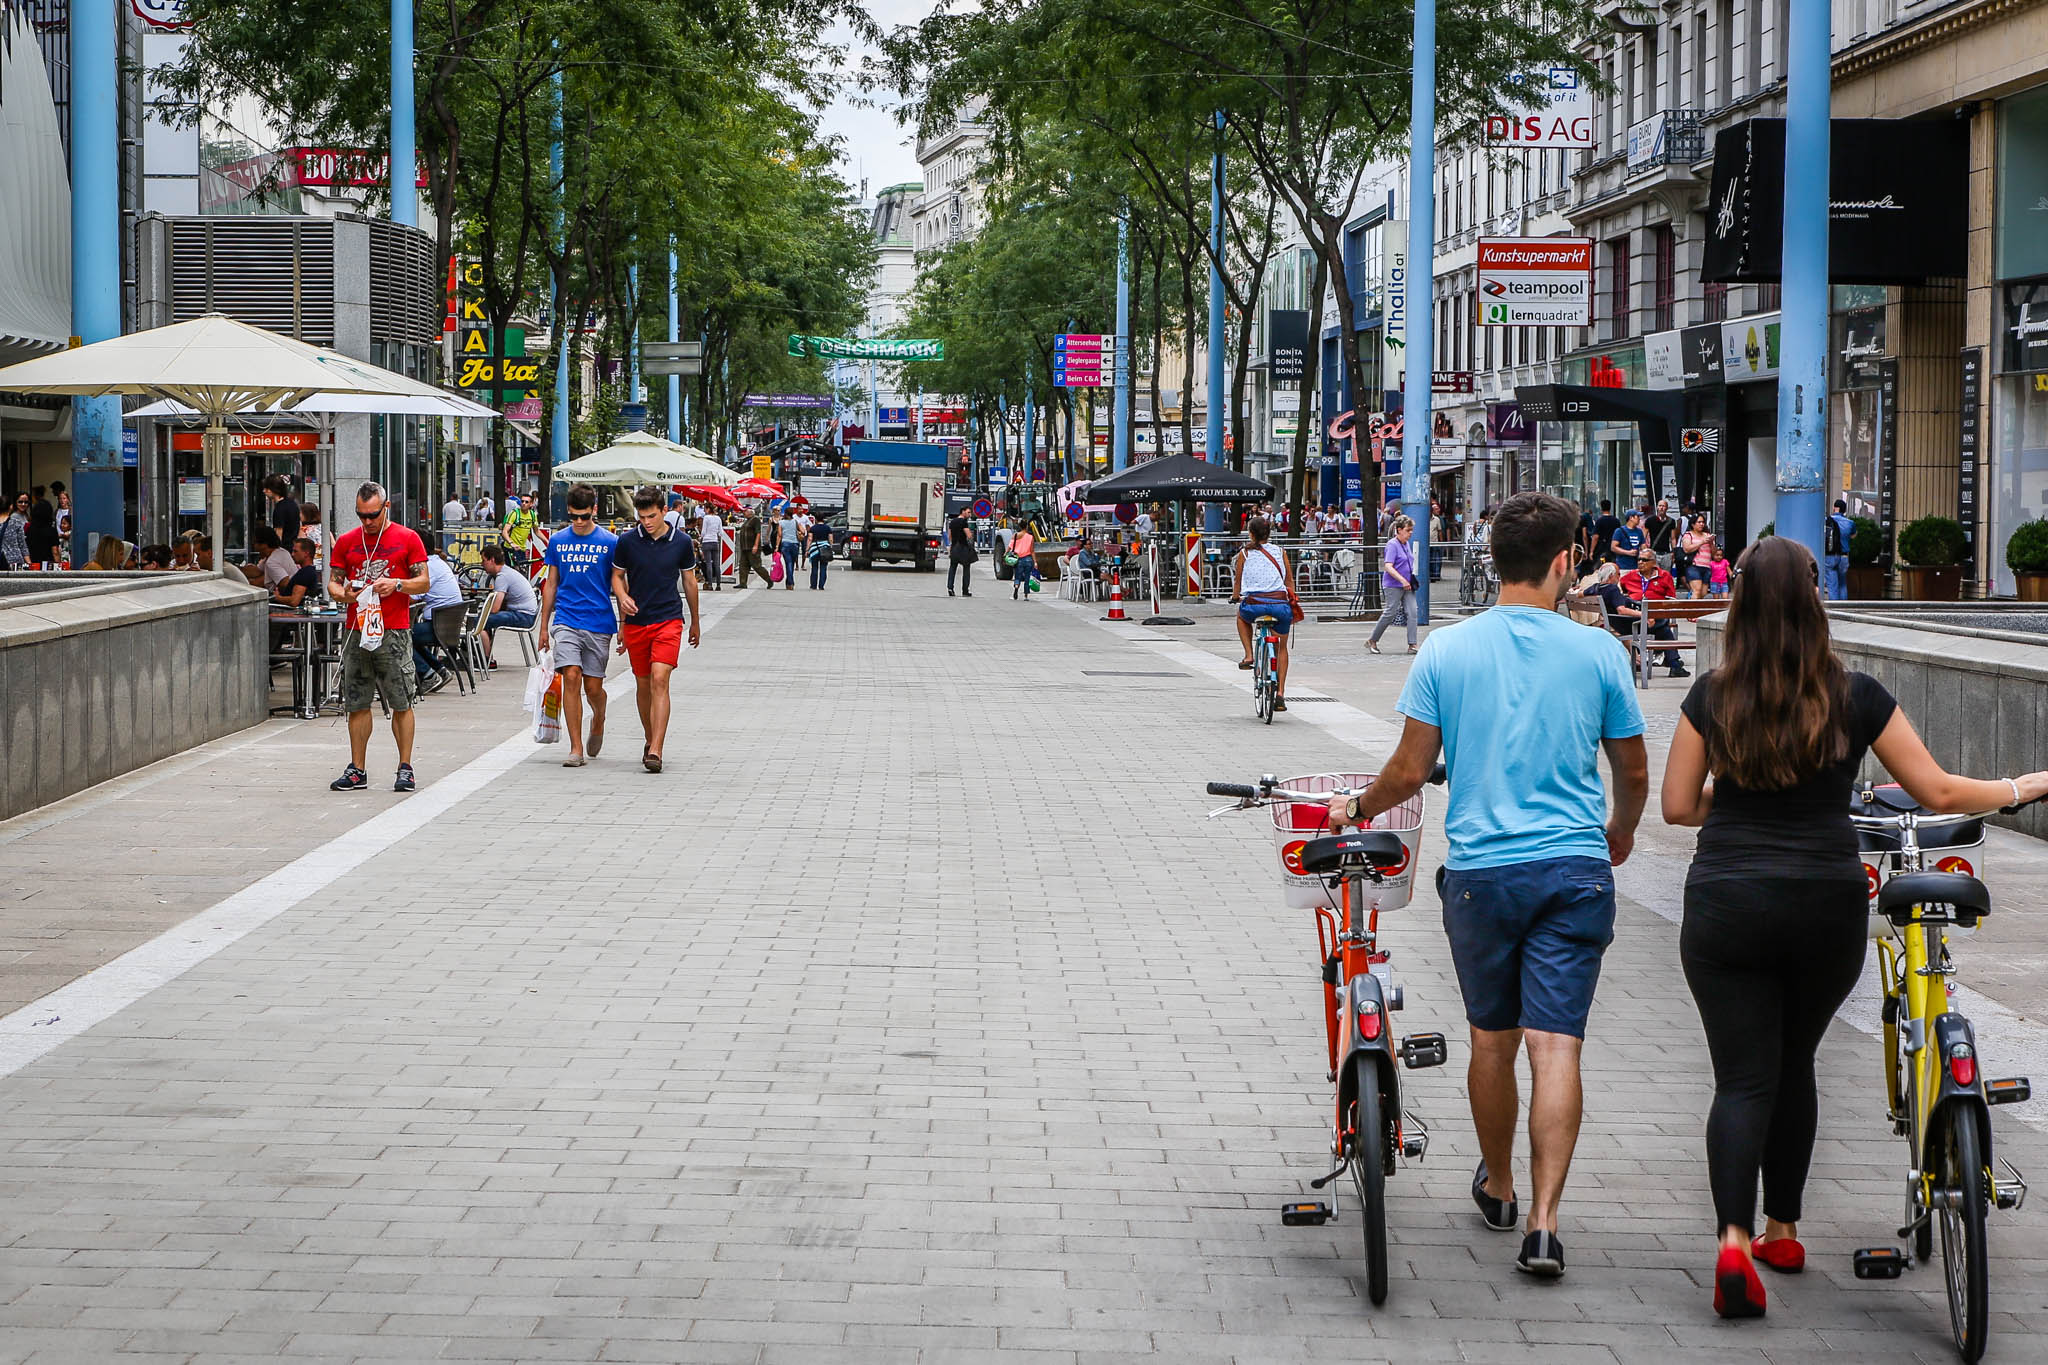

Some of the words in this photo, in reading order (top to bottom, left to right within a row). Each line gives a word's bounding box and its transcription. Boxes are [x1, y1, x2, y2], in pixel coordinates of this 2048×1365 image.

[1554, 92, 1566, 102] of
[1569, 92, 1576, 102] it
[1487, 116, 1541, 141] DIS
[1548, 117, 1590, 141] AG
[1482, 248, 1586, 266] Kunstsupermarkt
[1508, 280, 1583, 297] teampool
[1512, 310, 1578, 323] lernquadrat
[820, 342, 936, 356] DEICHMANN
[1067, 357, 1100, 365] Zieglergasse
[459, 359, 538, 387] Joka
[1563, 402, 1590, 412] 103
[243, 436, 271, 446] Linie
[274, 436, 290, 446] U3
[556, 544, 608, 553] QUARTERS
[561, 554, 598, 563] LEAGUE
[570, 565, 589, 573] A&F
